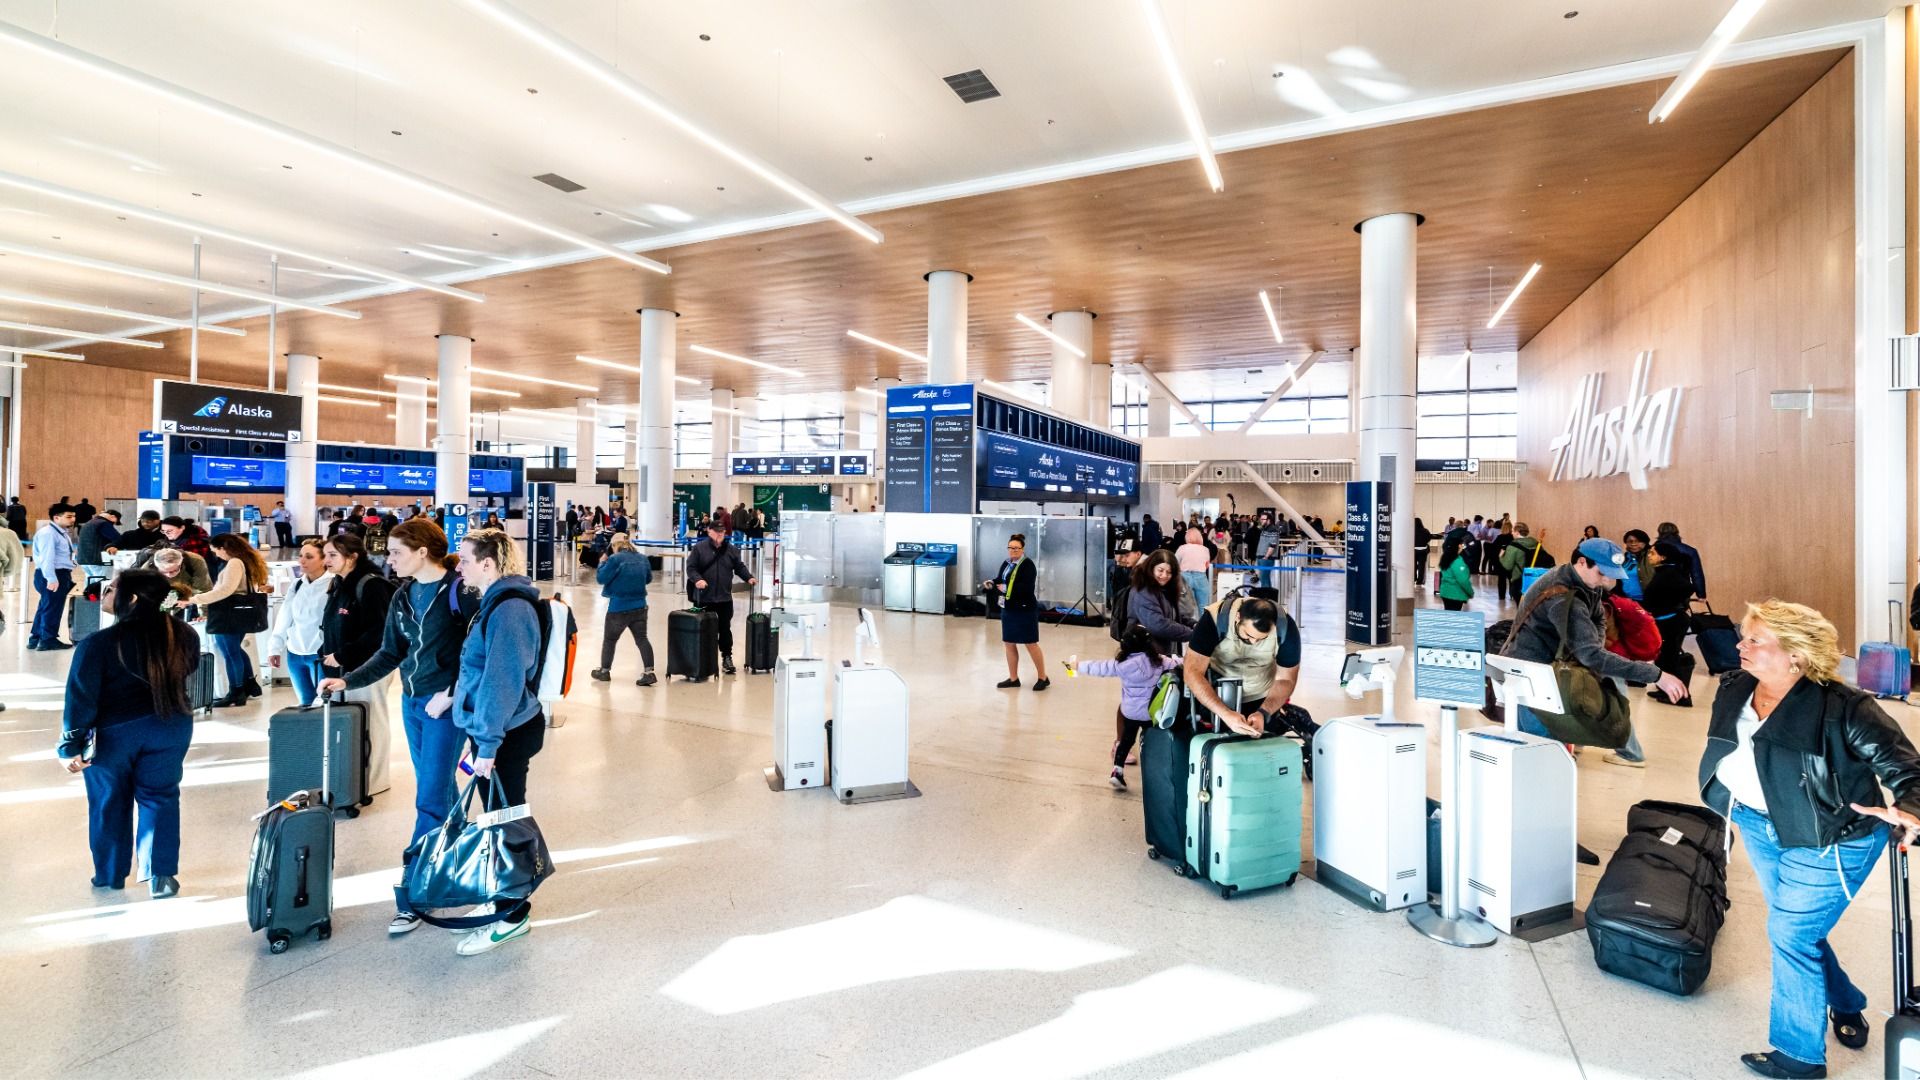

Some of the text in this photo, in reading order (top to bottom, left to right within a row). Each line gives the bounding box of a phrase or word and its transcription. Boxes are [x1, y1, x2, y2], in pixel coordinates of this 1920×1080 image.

[912, 389, 938, 399] Alaska
[227, 403, 273, 418] Alaska
[1548, 349, 1683, 490] Alaska
[179, 424, 200, 432] Special
[1038, 453, 1053, 467] Alaska
[398, 469, 422, 478] Alaska
[456, 506, 462, 515] 1
[1347, 503, 1358, 512] First
[1378, 503, 1389, 512] First
[1347, 512, 1369, 522] Class &
[453, 523, 466, 541] Tag
[1347, 523, 1366, 532] Atmos
[1347, 532, 1364, 542] Status
